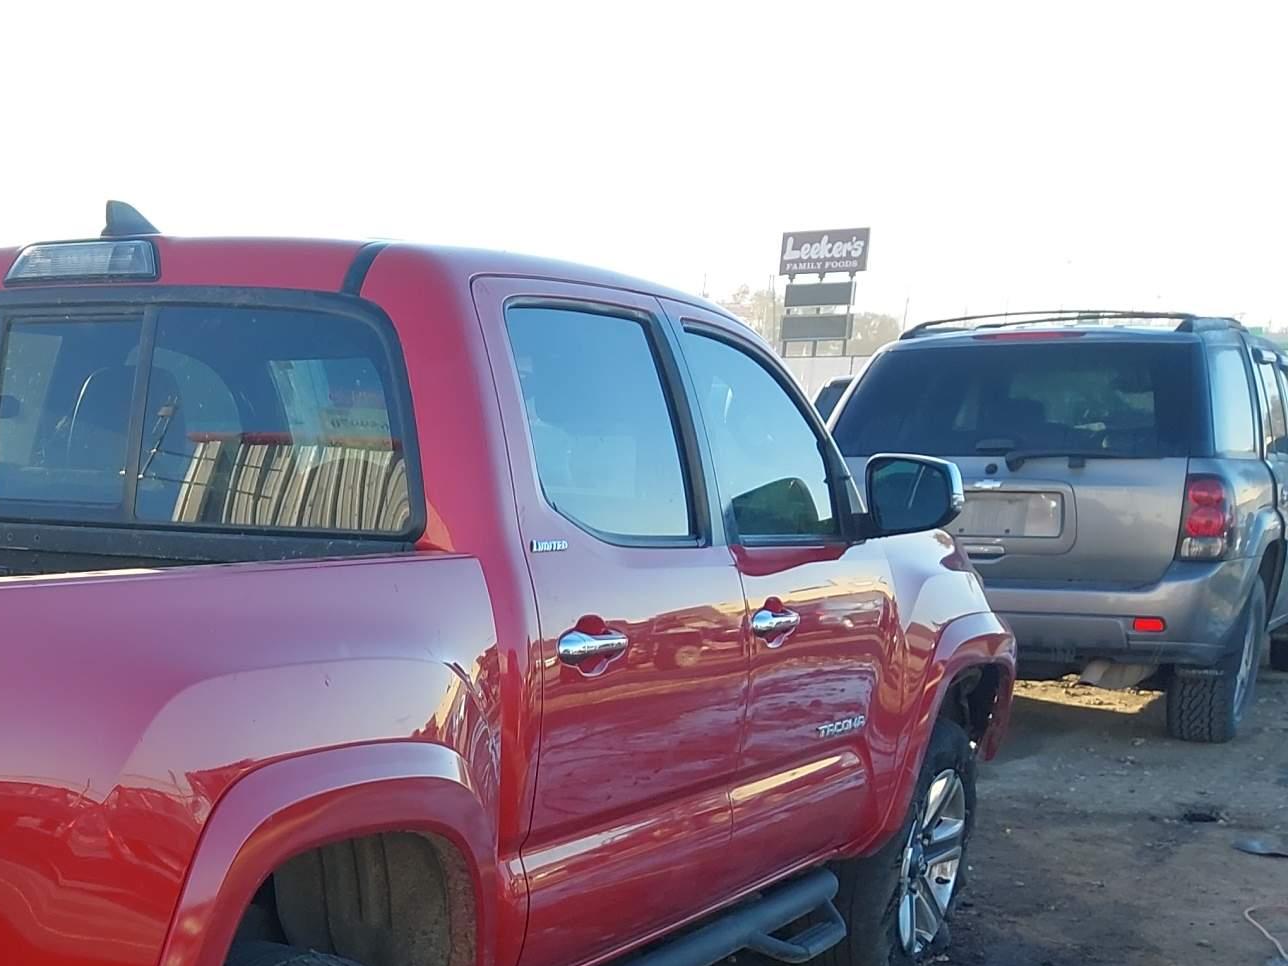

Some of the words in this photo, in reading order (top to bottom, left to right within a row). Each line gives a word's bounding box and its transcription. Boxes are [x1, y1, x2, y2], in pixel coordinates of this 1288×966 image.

[783, 235, 864, 260] Leeker's
[786, 261, 823, 271] FAMILY
[825, 260, 858, 269] FOODS
